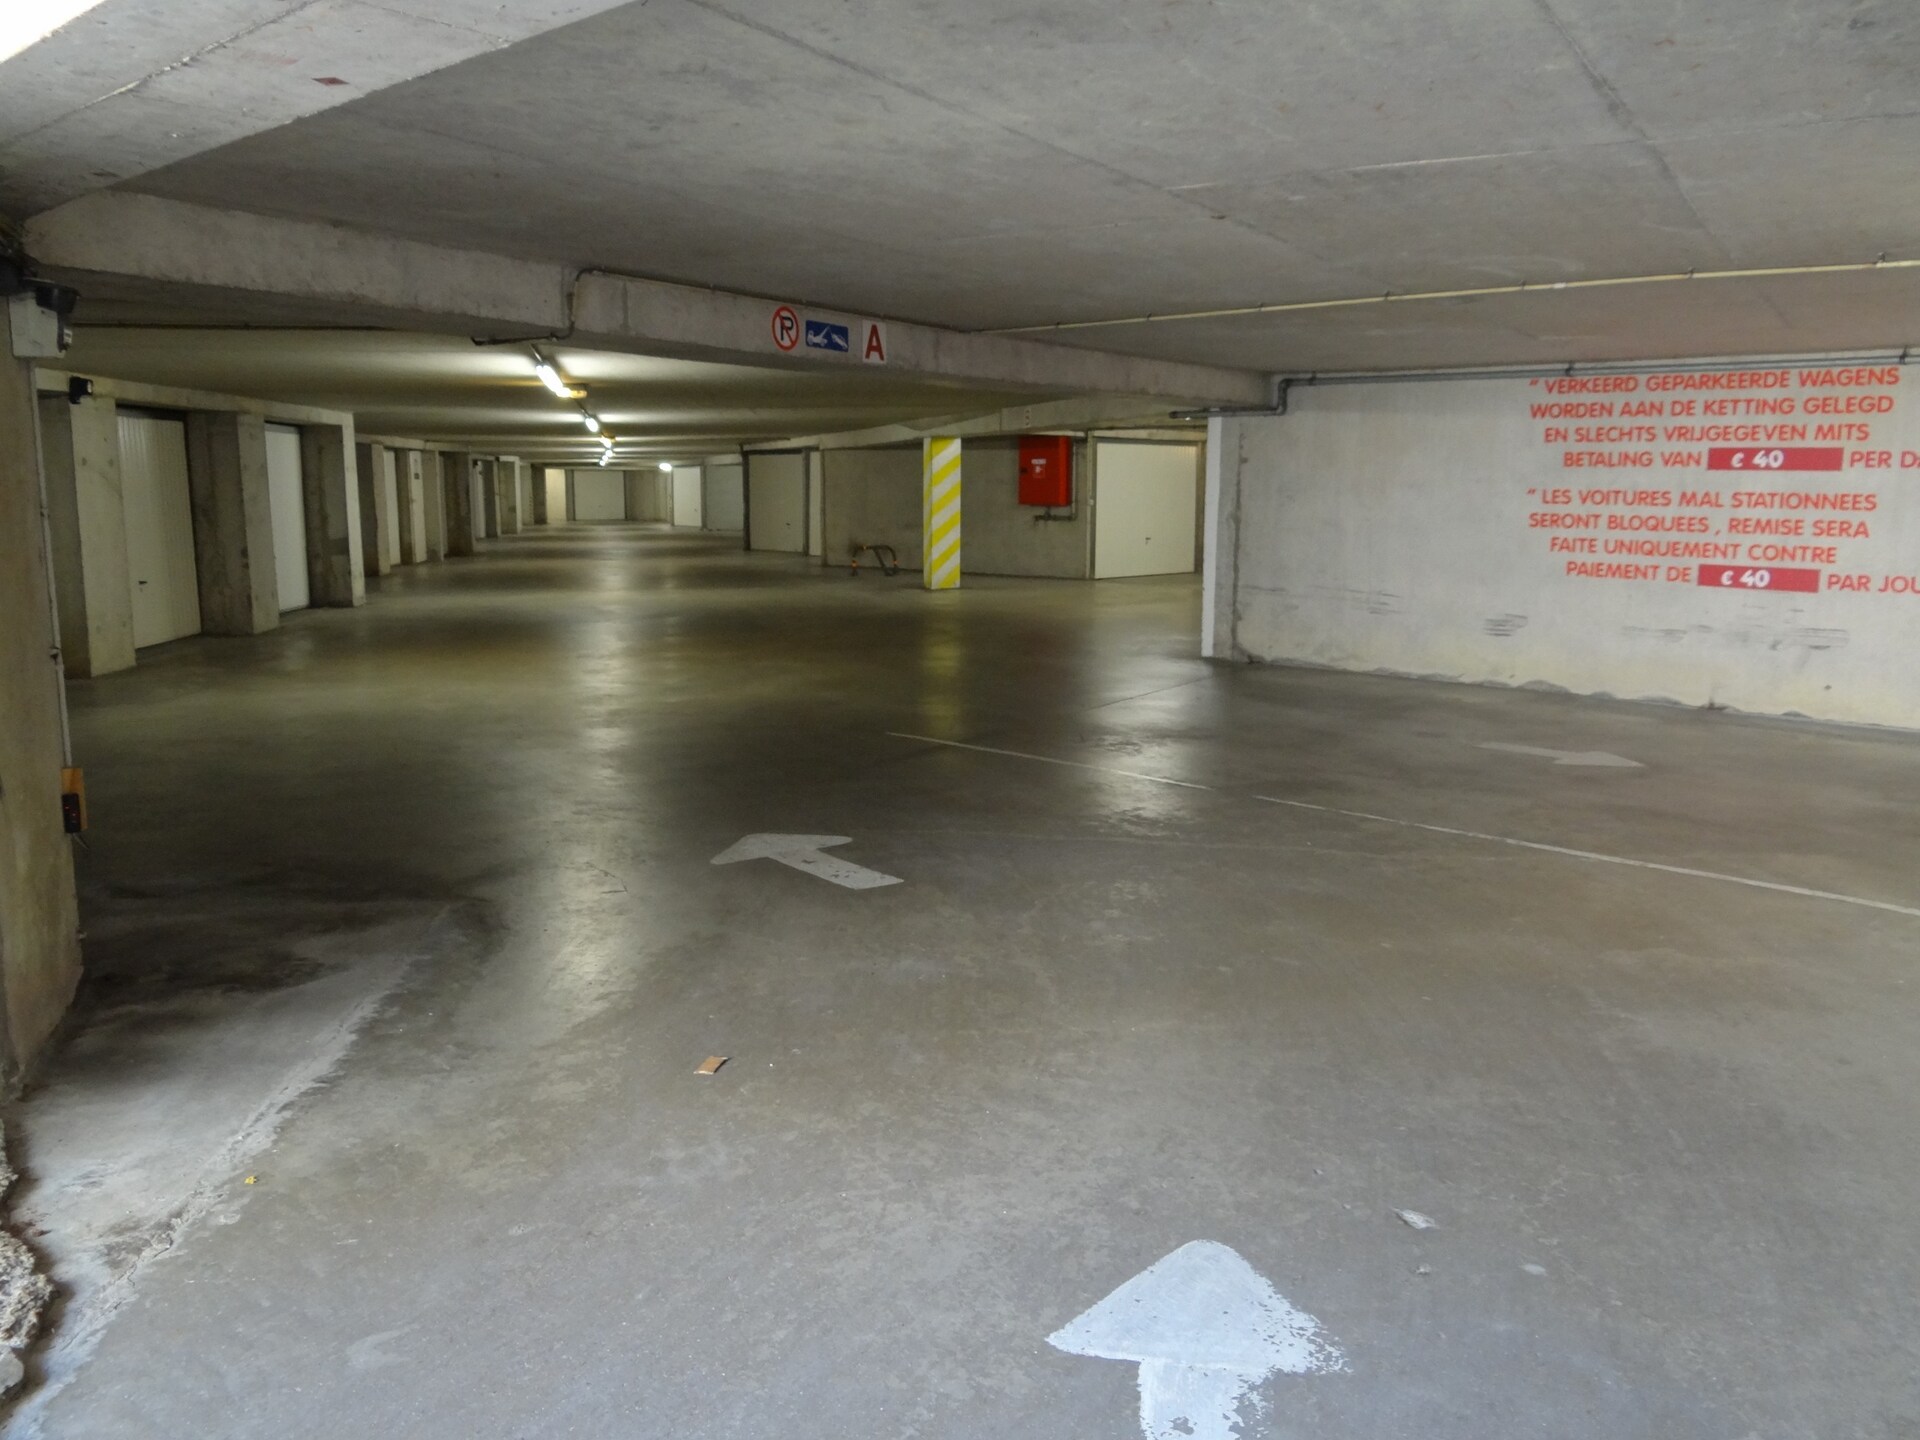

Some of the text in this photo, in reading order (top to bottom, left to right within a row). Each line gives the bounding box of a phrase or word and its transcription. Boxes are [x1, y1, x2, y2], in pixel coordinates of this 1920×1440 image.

[865, 323, 885, 361] A
[1544, 375, 1639, 395] VERKEERD
[1645, 371, 1791, 392] GEPARKEERDE
[1799, 367, 1900, 388] WAGENS
[1530, 395, 1895, 420] WORDEN AAN DE KETTING GELEGD
[1544, 424, 1871, 443] EN SLECHTS VRIJGEGEVEN MITS
[1563, 451, 1654, 468] BETALING
[1660, 451, 1702, 467] VAN
[1752, 449, 1785, 469] 40
[1850, 450, 1893, 469] PER
[1542, 489, 1572, 505] LES
[1578, 489, 1672, 507] VOITURES
[1678, 491, 1724, 508] MAL
[1731, 491, 1878, 512] STATIONNEES
[1529, 512, 1602, 530] SERONT
[1728, 517, 1805, 536] REMISE
[1812, 519, 1870, 539] SERA
[1550, 536, 1838, 564] FAITE UNIQUEMENT CONTRE
[1566, 561, 1661, 580] PAIEMENT
[1666, 566, 1692, 583] DE
[1739, 569, 1772, 588] 40
[1827, 573, 1872, 592] PAR
